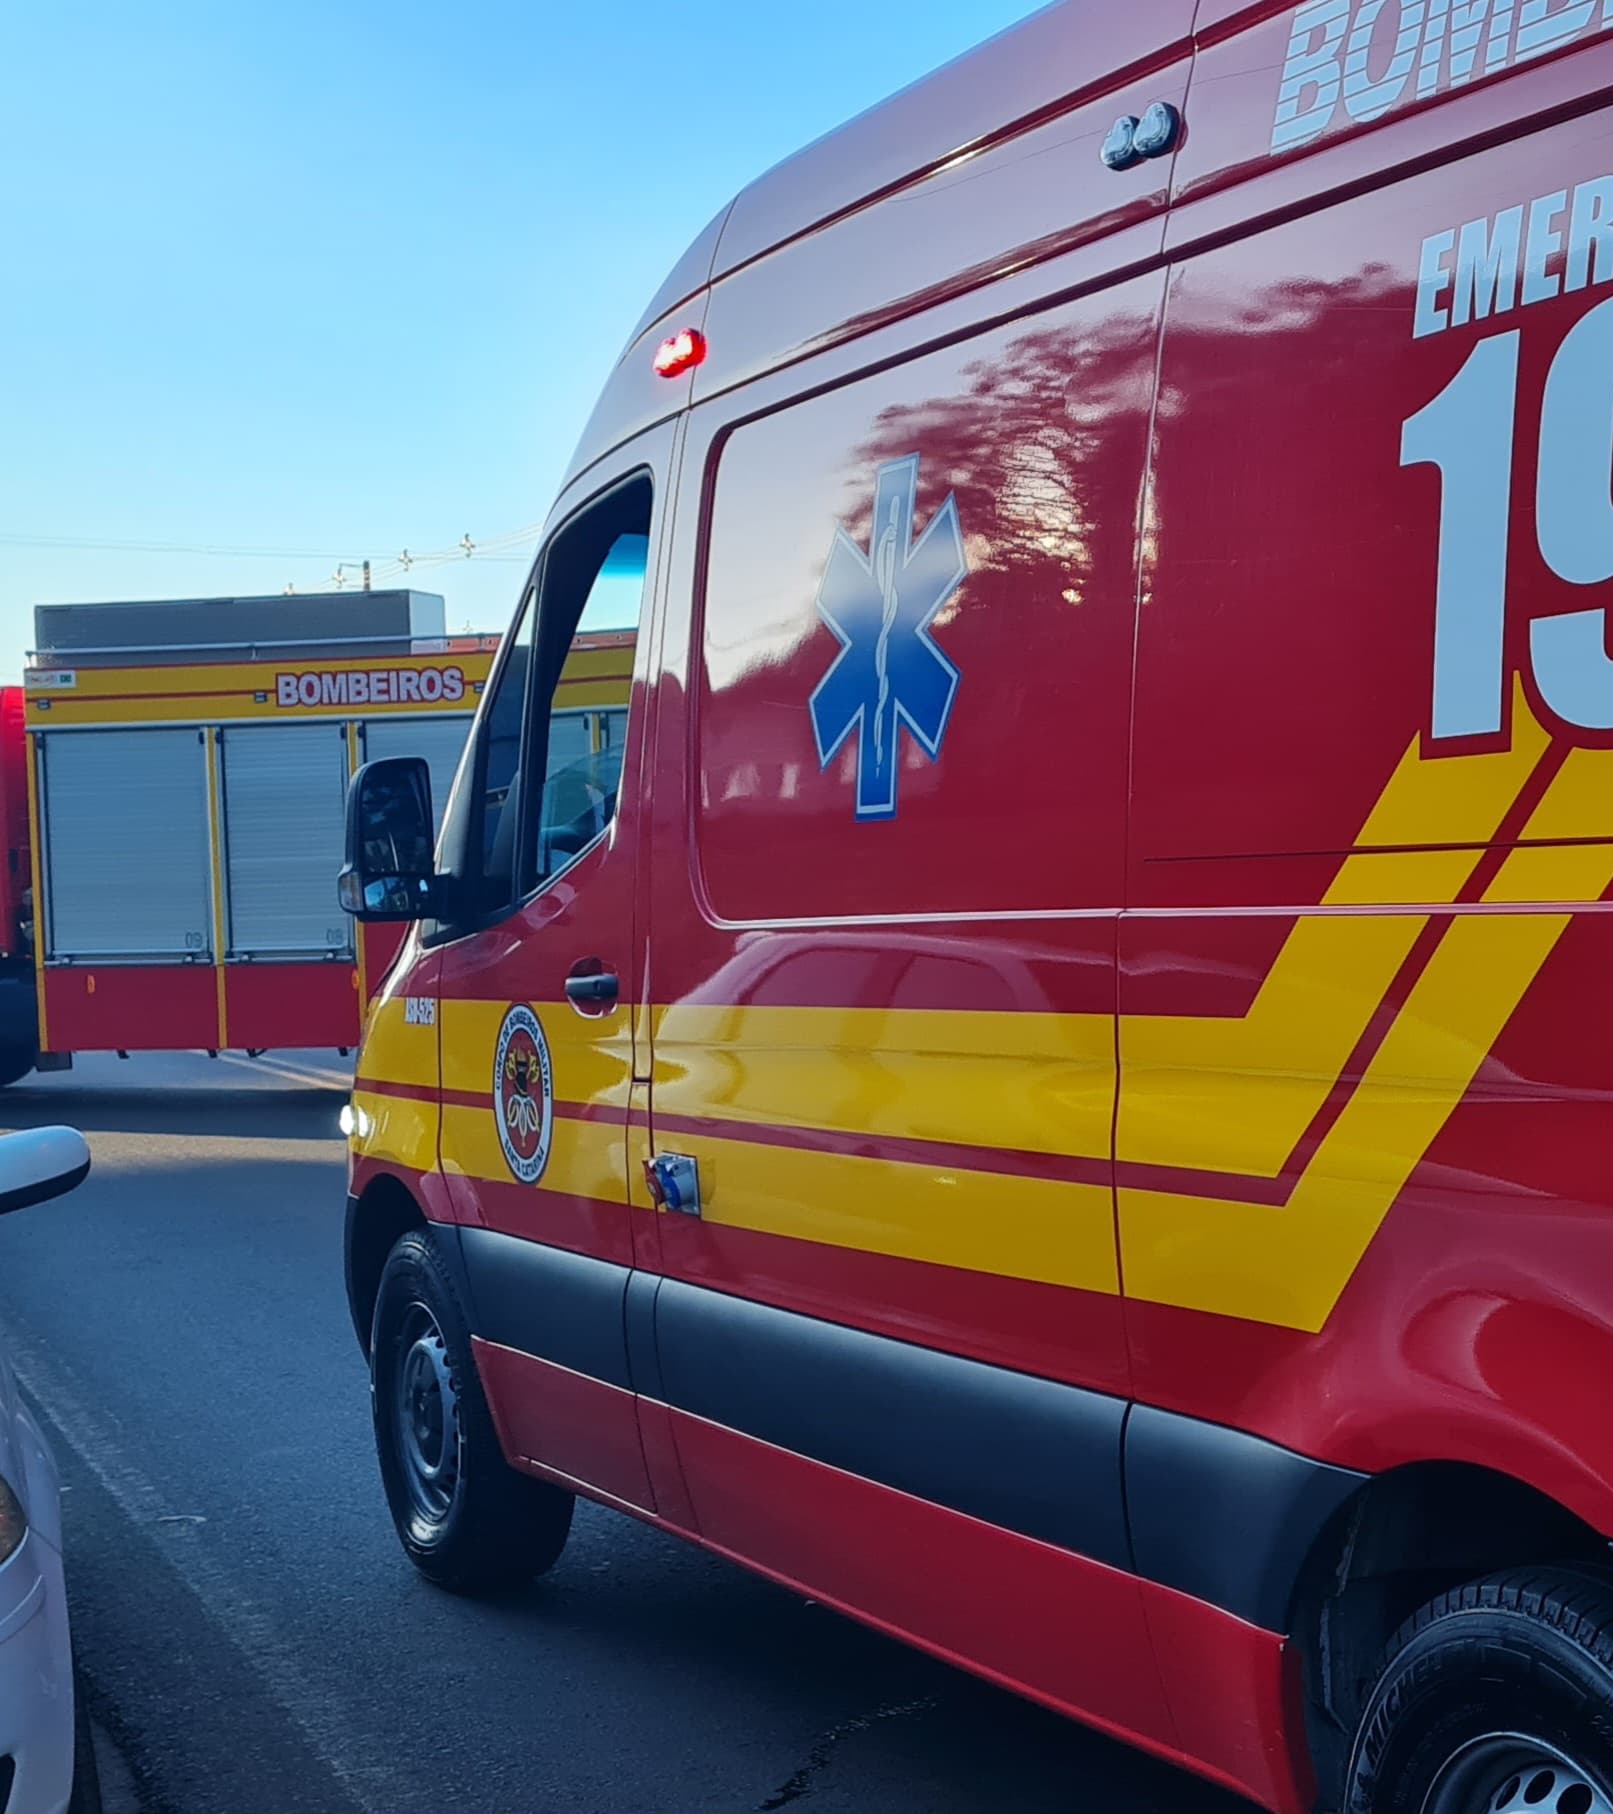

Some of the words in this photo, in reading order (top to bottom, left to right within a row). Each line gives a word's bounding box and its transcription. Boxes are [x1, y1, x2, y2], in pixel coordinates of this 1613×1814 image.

[276, 666, 465, 707] BOMBEIROS
[185, 931, 203, 949] 09
[404, 996, 436, 1029] ASU-525
